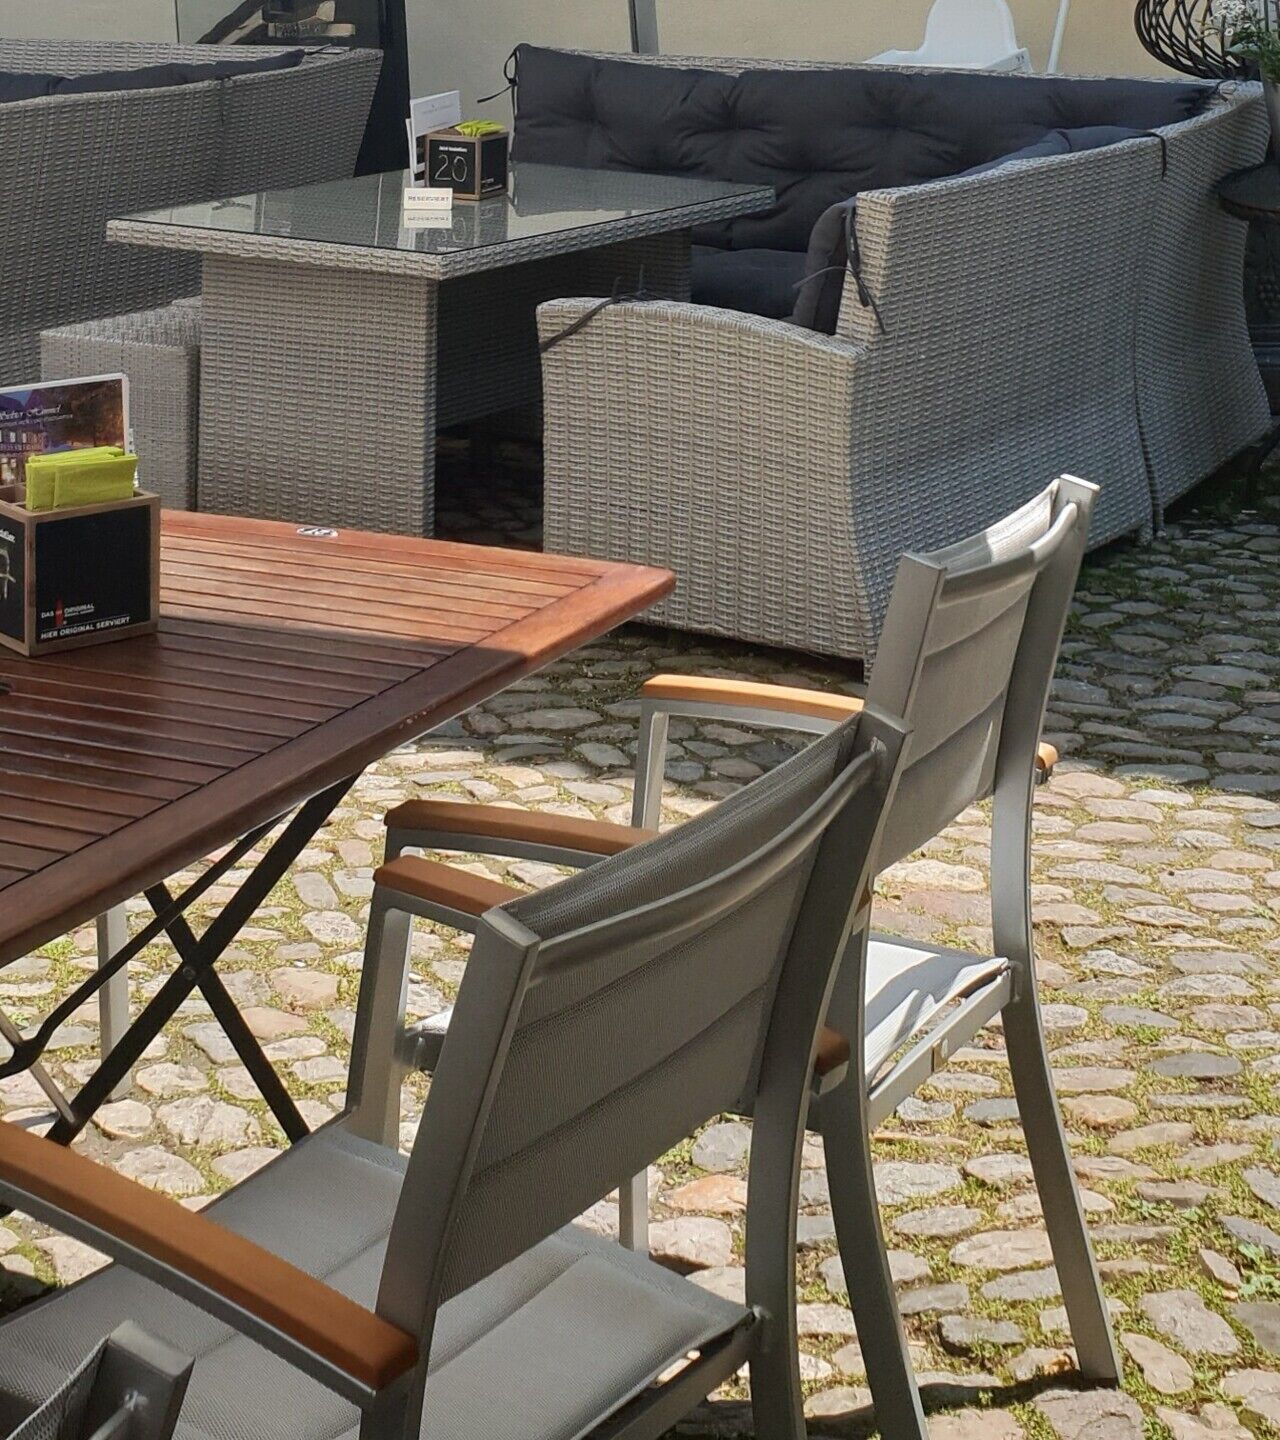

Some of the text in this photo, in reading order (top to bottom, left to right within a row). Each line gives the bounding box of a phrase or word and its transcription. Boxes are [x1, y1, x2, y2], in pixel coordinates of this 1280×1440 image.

[434, 154, 468, 182] 20
[40, 616, 131, 640] HIER ORIGINAL SERVIERT
